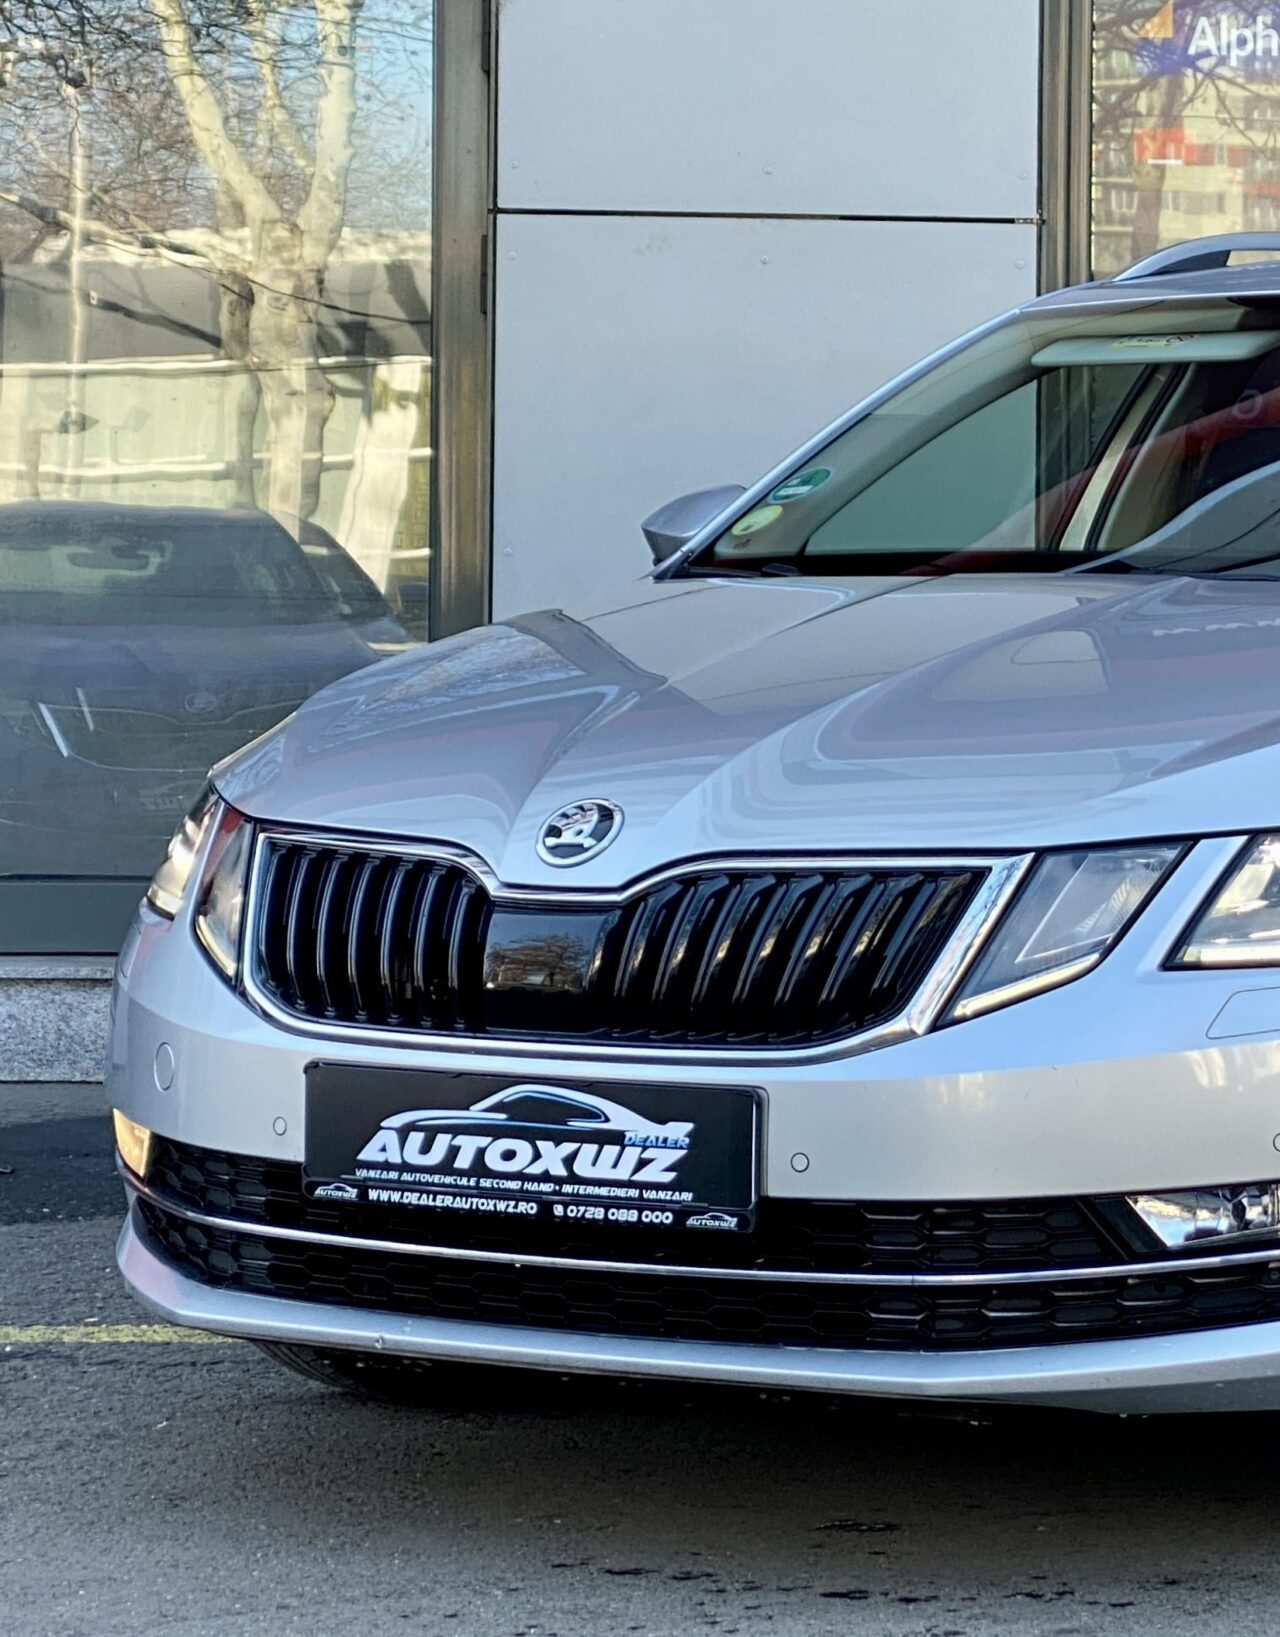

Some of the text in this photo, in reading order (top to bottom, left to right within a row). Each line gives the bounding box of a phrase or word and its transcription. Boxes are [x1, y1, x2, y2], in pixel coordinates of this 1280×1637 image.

[623, 1131, 690, 1149] DEALER
[356, 1129, 689, 1183] AUTOXWZ
[355, 1168, 399, 1180] VANZARI
[400, 1172, 477, 1187] AUTOVEHICULE
[479, 1177, 521, 1190] SECOND
[561, 1184, 640, 1198] INTERMEDIERI
[642, 1189, 693, 1201] VANZARI
[368, 1188, 537, 1215] WWW.DEALERAUTOXWZ.RO
[566, 1205, 674, 1224] 0728 088 000
[686, 1215, 738, 1228] AUTOXWZ
